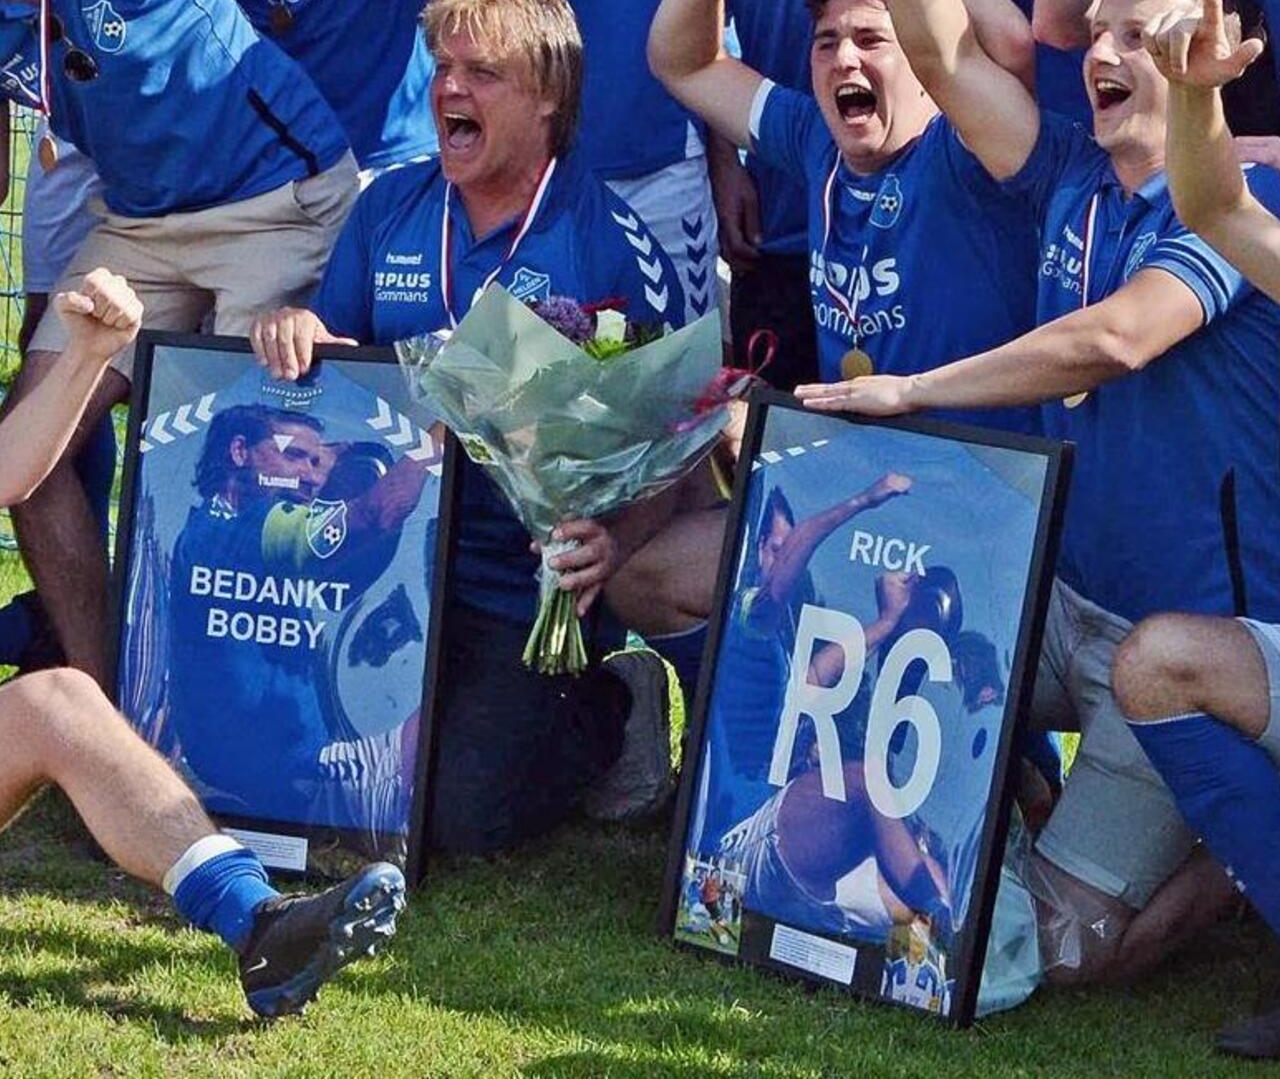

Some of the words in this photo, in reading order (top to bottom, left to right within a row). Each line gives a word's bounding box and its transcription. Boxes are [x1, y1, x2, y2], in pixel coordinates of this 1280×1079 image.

[374, 287, 428, 303] Gommans
[386, 272, 431, 288] PLUS
[849, 530, 931, 577] RICK
[190, 565, 351, 611] BEDANKT
[207, 608, 326, 649] BOBBY
[767, 603, 953, 819] R6
